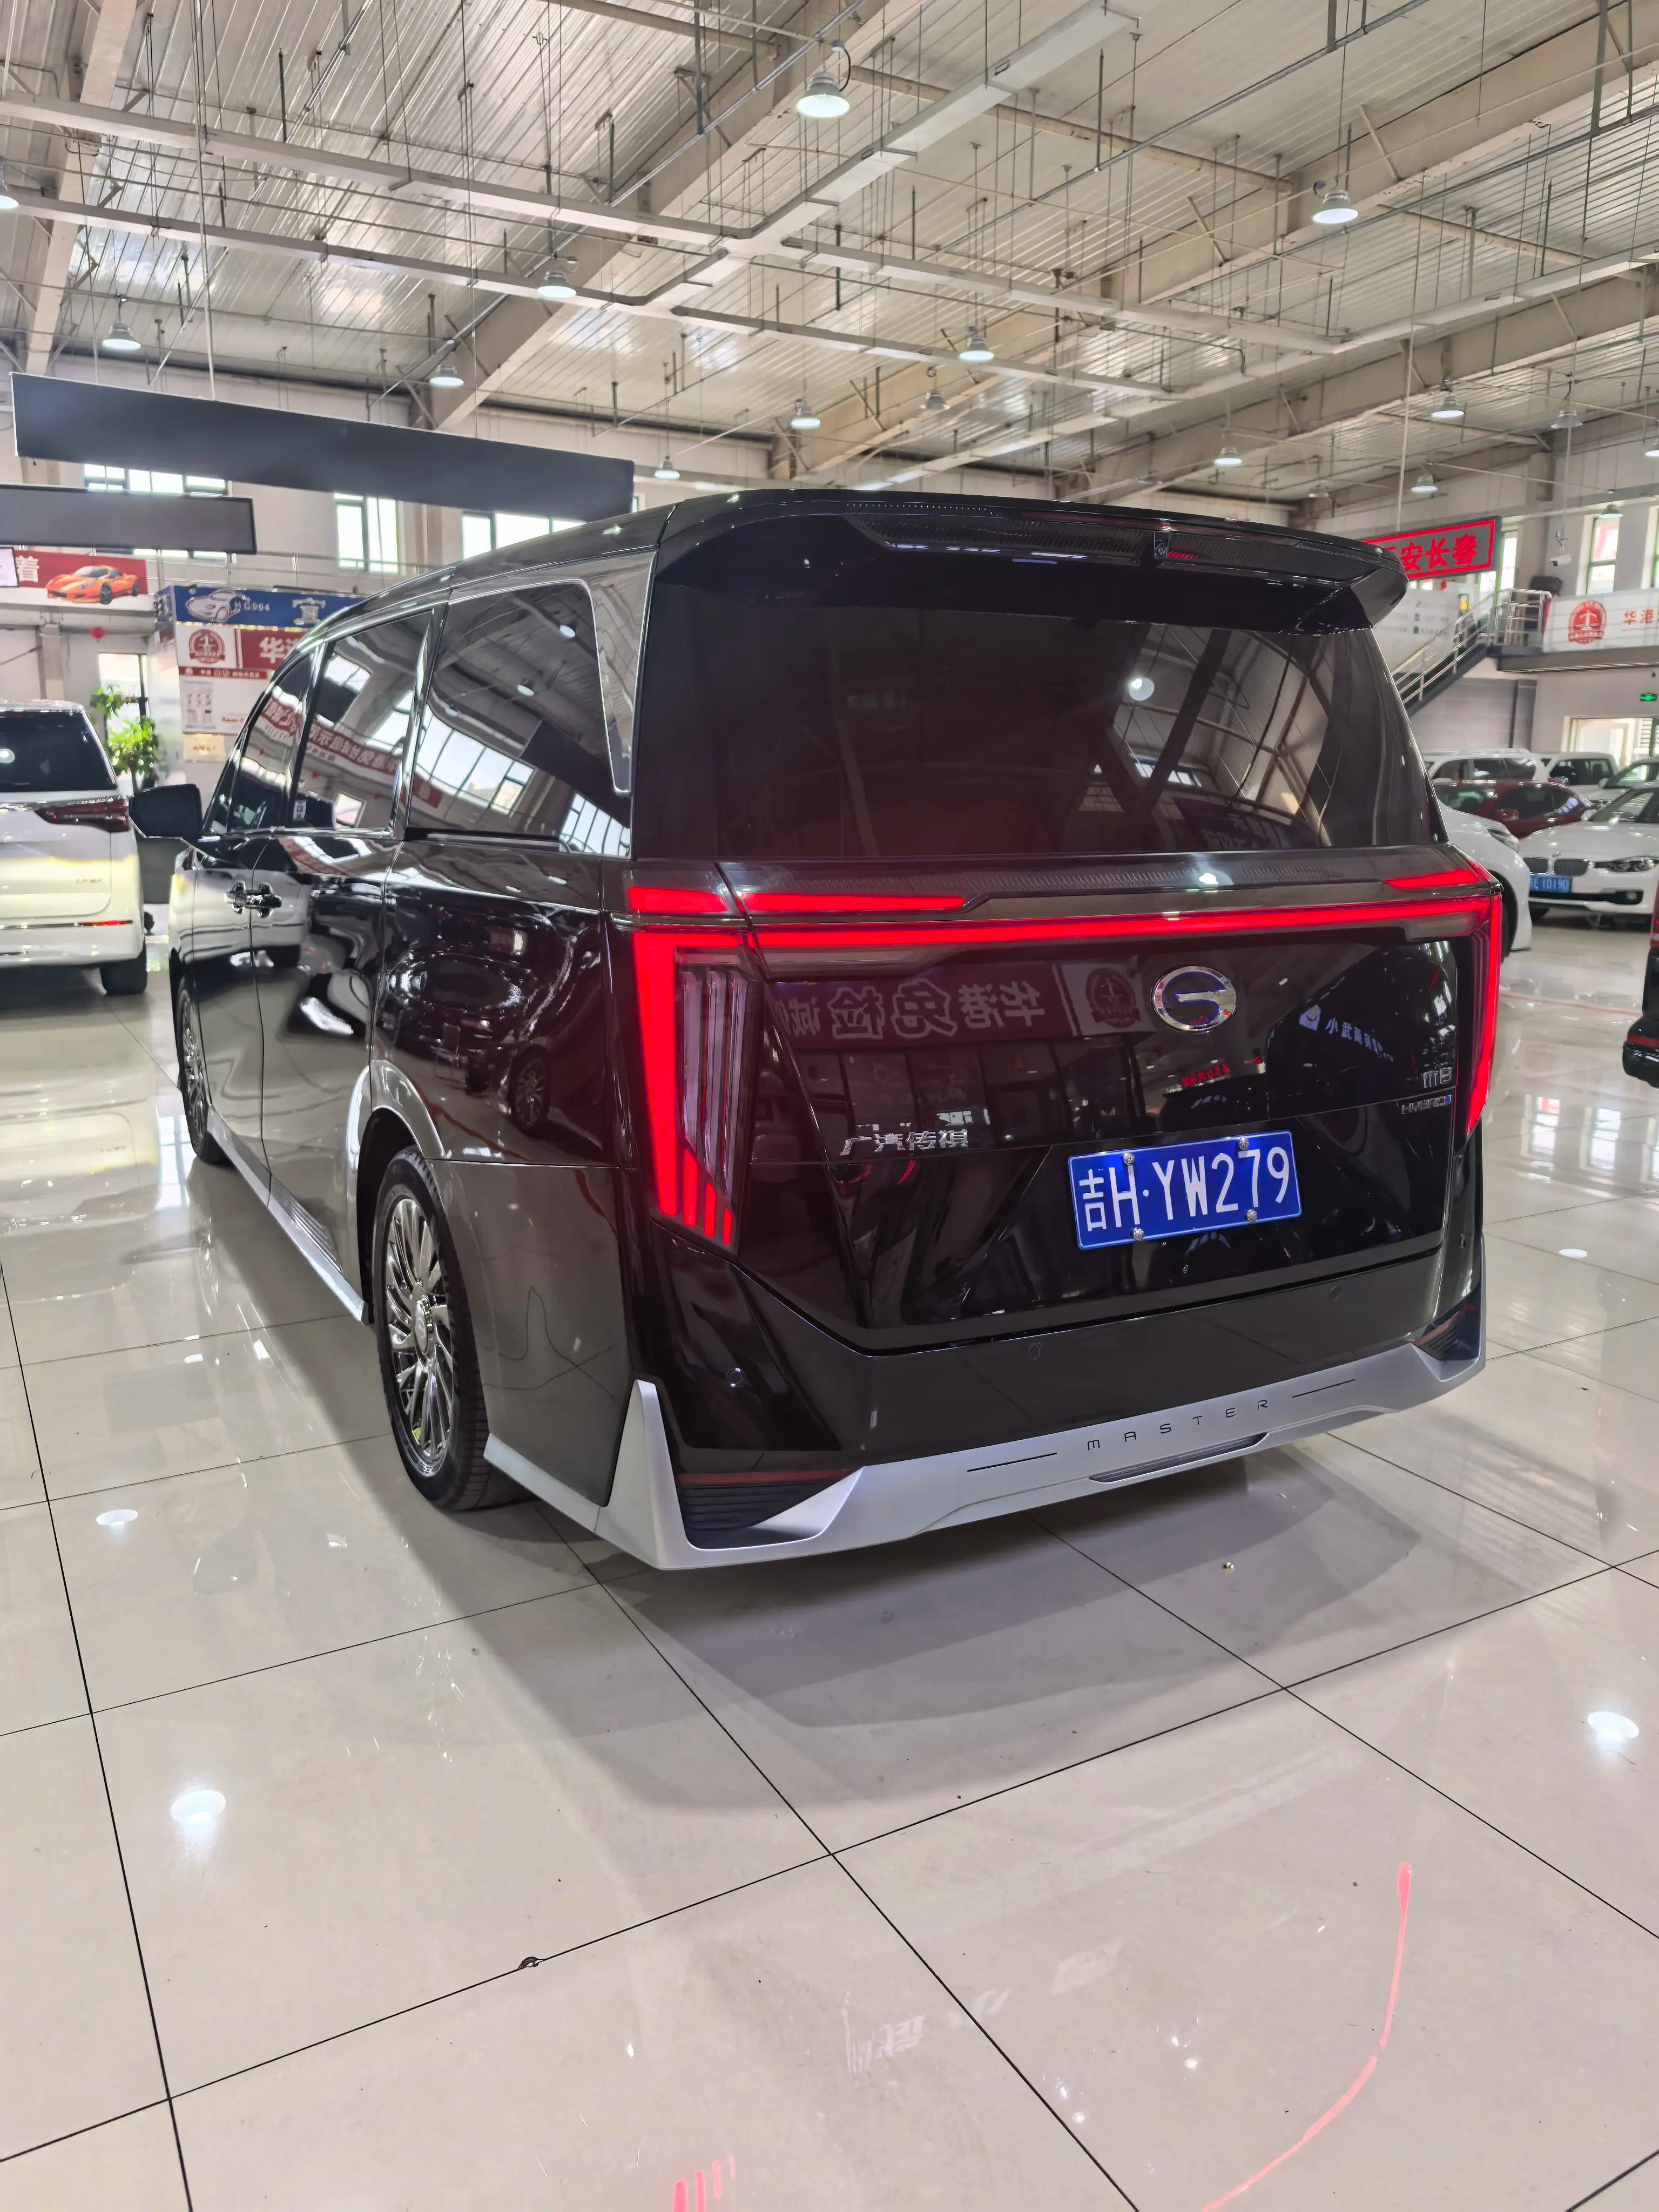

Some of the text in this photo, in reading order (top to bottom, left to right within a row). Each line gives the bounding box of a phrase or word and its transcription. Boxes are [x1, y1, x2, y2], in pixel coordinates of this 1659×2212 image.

[1387, 532, 1478, 572] 安长春
[839, 1129, 968, 1156] 广汽传祺
[1087, 1399, 1268, 1451] MASTER
